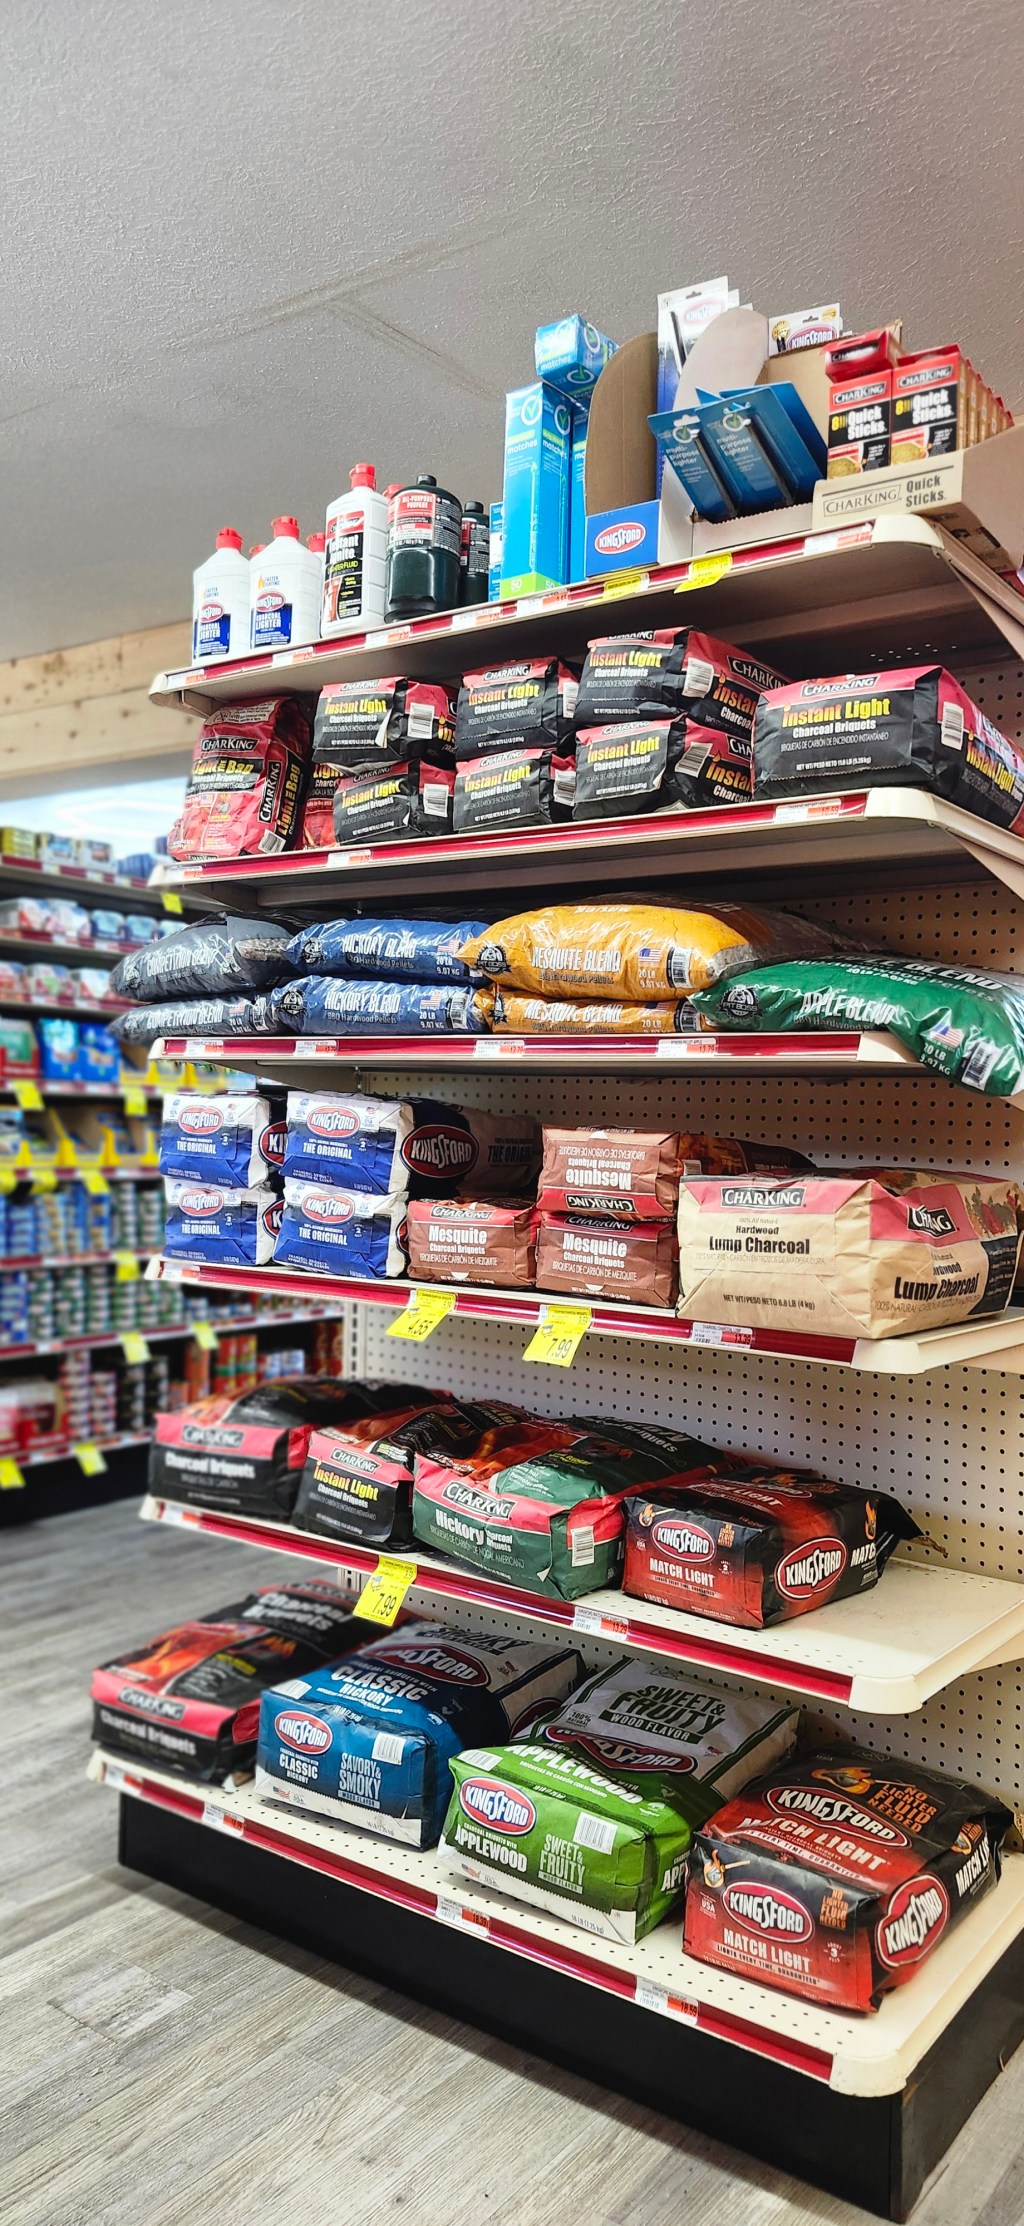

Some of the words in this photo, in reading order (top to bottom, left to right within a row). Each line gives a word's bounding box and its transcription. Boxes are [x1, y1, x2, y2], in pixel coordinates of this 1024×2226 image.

[791, 330, 832, 348] KINGSFORD
[541, 356, 571, 370] matches
[900, 368, 950, 387] CHARKING
[835, 383, 883, 404] CHARKING
[896, 400, 903, 415] 8
[913, 389, 948, 409] Quick
[832, 416, 838, 431] 8
[848, 406, 882, 424] Quick
[913, 404, 951, 424] Sticks
[848, 421, 885, 440] Sticks
[508, 440, 538, 454] matches
[542, 440, 566, 459] matches
[720, 438, 752, 450] purpose
[724, 446, 748, 456] lighter
[670, 450, 700, 460] purpose
[673, 458, 697, 466] lighter
[826, 490, 897, 514] CHARKING
[906, 475, 941, 493] Quick
[906, 490, 944, 508] Sticks
[599, 528, 641, 549] KINGSFORD
[511, 579, 522, 590] 50
[256, 619, 281, 630] LIGHTER
[484, 666, 529, 681] CHARKING
[804, 678, 874, 696] CHARKING
[475, 702, 500, 715] Charcoal
[501, 699, 527, 710] Briquets
[845, 698, 890, 719] Light
[603, 722, 650, 734] CHARKING
[793, 723, 833, 738] Charcoal
[835, 720, 876, 733] Briquets
[202, 739, 253, 750] CHARKING
[227, 760, 254, 774] Bag
[481, 751, 523, 766] CHARKING
[286, 764, 300, 792] Bag
[260, 763, 280, 821] CHARKING
[471, 787, 496, 800] Charcoal
[496, 781, 521, 794] Briquets
[342, 934, 384, 955] HICKORY
[385, 935, 416, 958] BLEND
[583, 949, 622, 973] BLEND
[638, 970, 646, 978] 20
[647, 970, 655, 978] LB
[904, 963, 1004, 990] BLEND
[324, 989, 366, 1011] HICKORY
[367, 992, 400, 1014] BLEND
[736, 1002, 757, 1012] BOSS
[200, 1005, 223, 1023] BLEND
[341, 1015, 374, 1023] Hardwood
[374, 1015, 397, 1024] Pellets
[419, 1012, 426, 1020] 20
[427, 1012, 435, 1020] LB
[420, 1020, 434, 1029] 9.07
[435, 1021, 444, 1029] KG
[181, 1112, 219, 1130] KINGSFORD
[310, 1112, 355, 1131] KINGSFORD
[177, 1141, 188, 1151] THE
[188, 1141, 217, 1155] ORIGINAL
[303, 1142, 315, 1154] THE
[316, 1145, 353, 1159] ORIGINAL
[411, 1134, 472, 1168] KINGSFORD
[568, 1158, 601, 1168] Briquets
[602, 1160, 630, 1170] Charcoal
[566, 1169, 632, 1190] Mesquite
[181, 1195, 219, 1211] KINGSFORD
[568, 1196, 632, 1211] CHARKING
[725, 1190, 800, 1205] CHARKING
[306, 1199, 350, 1217] KINGSFORD
[432, 1206, 489, 1219] CHARKING
[182, 1223, 191, 1233] THE
[191, 1224, 221, 1235] ORIGINAL
[569, 1216, 629, 1230] CHARKING
[736, 1225, 779, 1235] Hardwood
[299, 1227, 311, 1239] THE
[312, 1230, 347, 1246] ORIGINAL
[429, 1226, 488, 1244] Mesquite
[429, 1243, 456, 1253] Charcoal
[457, 1244, 485, 1255] Briquets
[562, 1233, 627, 1257] Mesquite
[710, 1236, 742, 1253] Lump
[745, 1237, 810, 1254] Charcoal
[563, 1252, 594, 1264] Charcoal
[594, 1256, 625, 1268] Briquets
[894, 1276, 938, 1301] Lump
[937, 1273, 979, 1299] Charcoal
[408, 1320, 433, 1335] 4.55
[546, 1338, 573, 1359] 7.99
[165, 1452, 208, 1472] Charcoal
[209, 1459, 255, 1478] Briquets
[332, 1451, 377, 1472] CHARKING
[318, 1483, 342, 1500] Charcoal
[343, 1494, 369, 1509] Briquets
[352, 1480, 378, 1501] Light
[436, 1509, 484, 1546] Hickory
[658, 1528, 709, 1553] KINGSFORD
[650, 1558, 683, 1580] MATCH
[686, 1568, 715, 1587] LIGHT
[785, 1549, 842, 1586] KINGSFORD
[372, 1593, 397, 1617] 7.99
[331, 1665, 428, 1701] CLASSIC
[339, 1684, 394, 1706] HICKORY
[609, 1692, 725, 1735] FRUITY
[101, 1710, 147, 1737] Charcoal
[148, 1726, 196, 1755] Briquets
[279, 1718, 328, 1746] KINGSFORD
[610, 1713, 644, 1729] WOOD
[644, 1721, 690, 1741] FLAVOR
[280, 1754, 318, 1779] CLASSIC
[504, 1744, 643, 1804] APPLEWOOD
[340, 1769, 380, 1800] SMOKY
[904, 1787, 928, 1801] NO
[465, 1786, 529, 1826] KINGSFORD
[873, 1791, 932, 1825] FLUID
[882, 1783, 938, 1816] LIGHTER
[778, 1789, 896, 1840] KINGSFORD
[868, 1798, 923, 1833] NEEDED
[455, 1824, 528, 1873] APPLEWOOD
[814, 1832, 887, 1871] LIGHT
[540, 1850, 585, 1886] FRUITY
[701, 1900, 715, 1913] USA
[729, 1892, 804, 1933] KINGSFORD
[884, 1888, 942, 1954] KINGSFORD
[724, 1928, 767, 1959] MATCH
[771, 1946, 811, 1973] LIGHT
[831, 1948, 838, 1957] 3
[680, 2000, 698, 2017] 18.59
